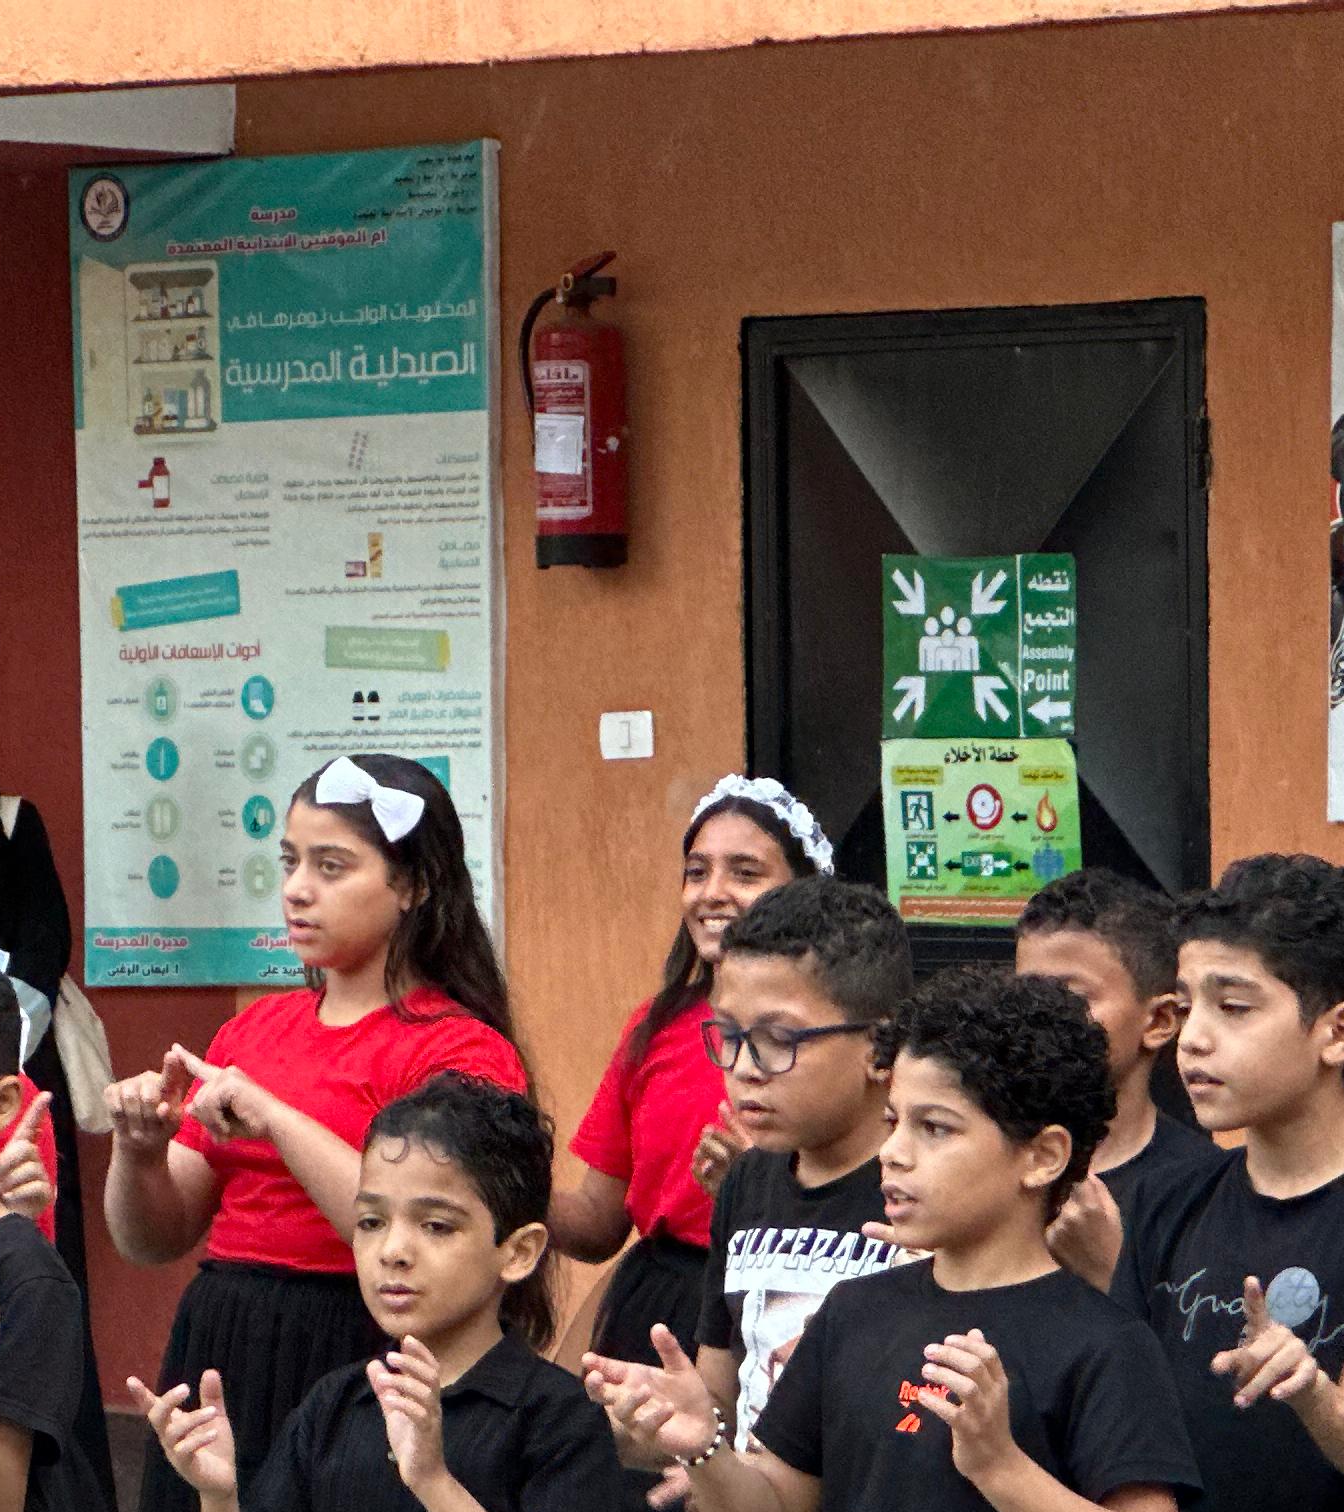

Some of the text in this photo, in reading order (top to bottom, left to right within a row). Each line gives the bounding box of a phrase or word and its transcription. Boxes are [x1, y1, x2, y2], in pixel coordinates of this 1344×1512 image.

[251, 207, 297, 225] مدرسة
[225, 342, 475, 394] الصيدلية المدرسية
[1023, 606, 1075, 635] التجمع
[227, 638, 261, 662] أدوات
[1023, 644, 1075, 663] Assembly
[1023, 668, 1070, 692] Point
